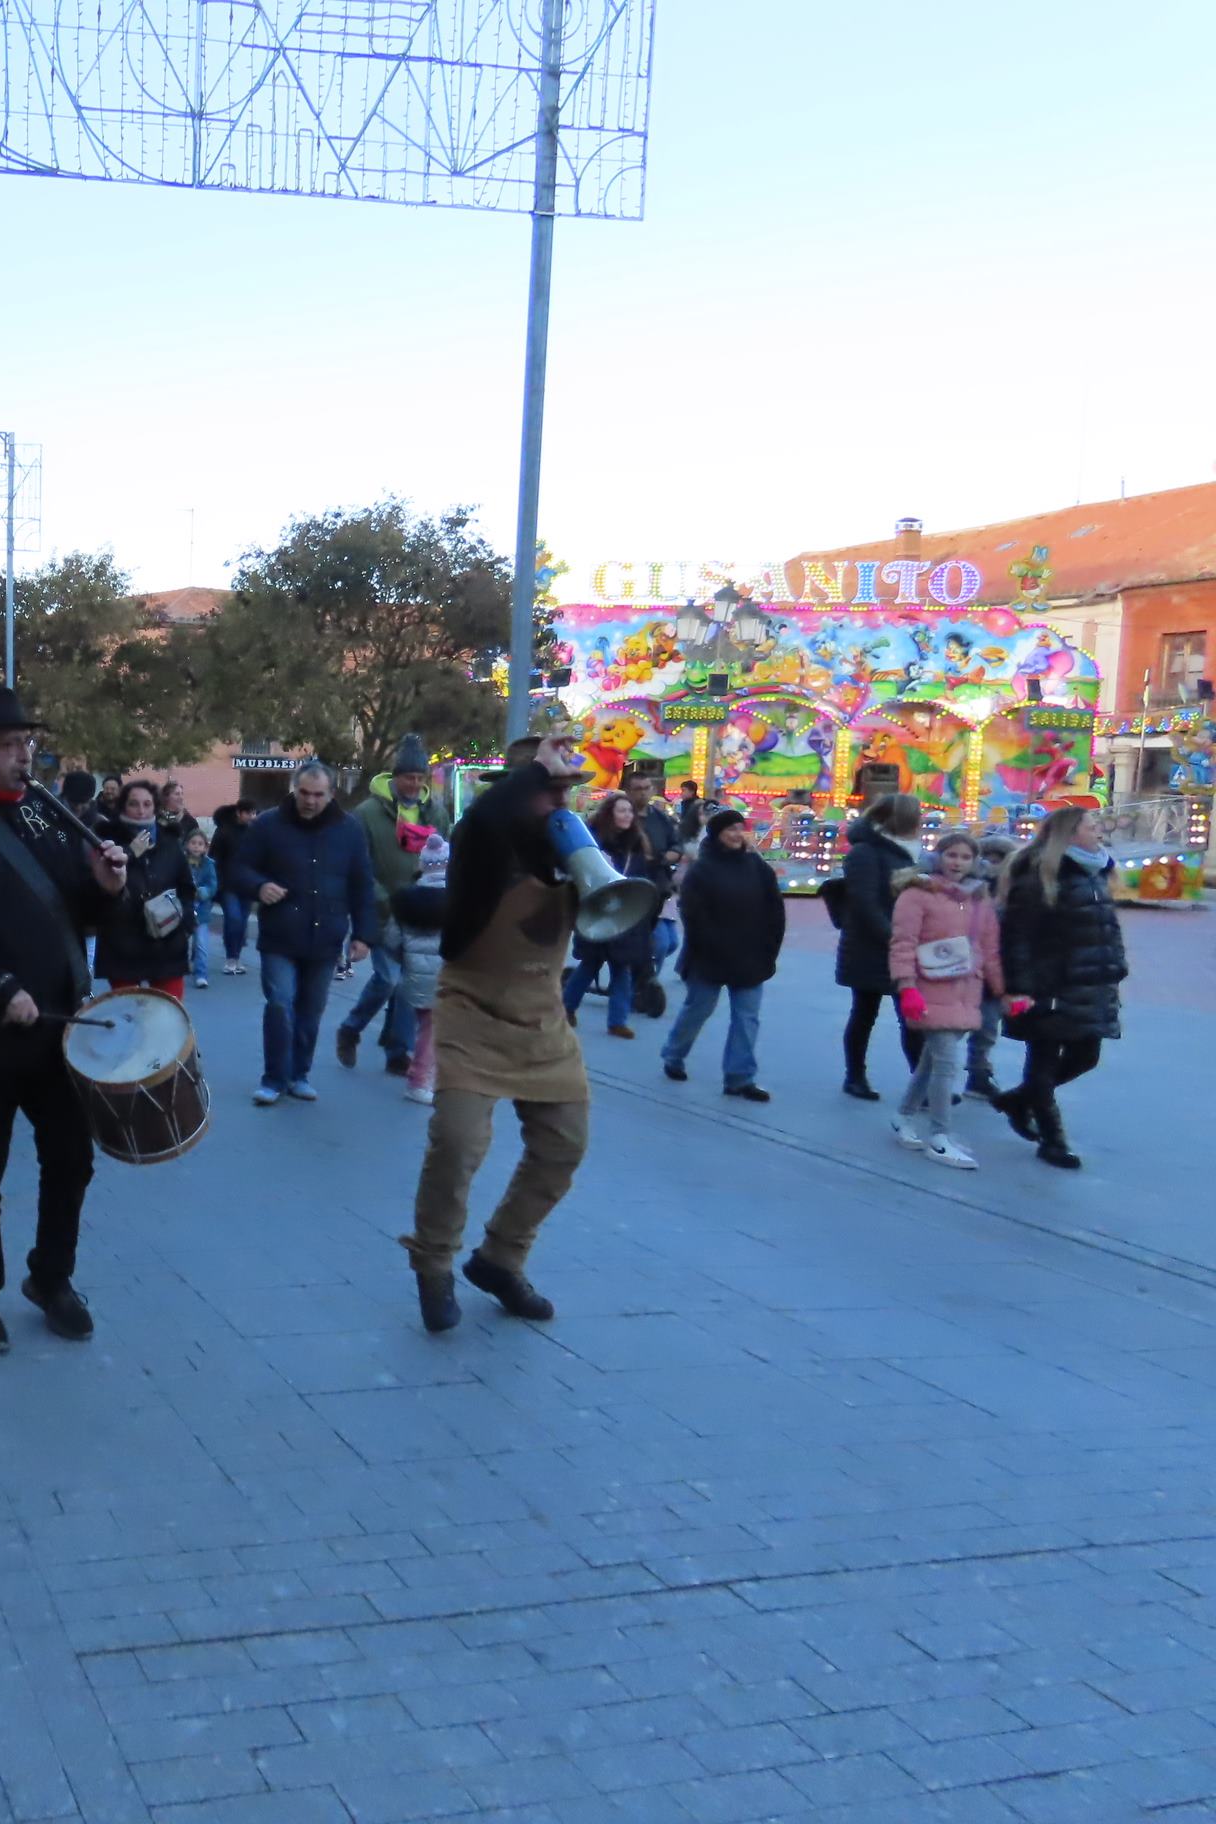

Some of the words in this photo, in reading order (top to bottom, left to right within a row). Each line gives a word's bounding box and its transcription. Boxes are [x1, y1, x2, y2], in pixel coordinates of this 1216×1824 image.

[590, 560, 982, 605] GUSANITO
[664, 705, 725, 720] ENTRADA
[1029, 710, 1091, 728] SALIDA
[235, 758, 295, 768] MUEBLES
